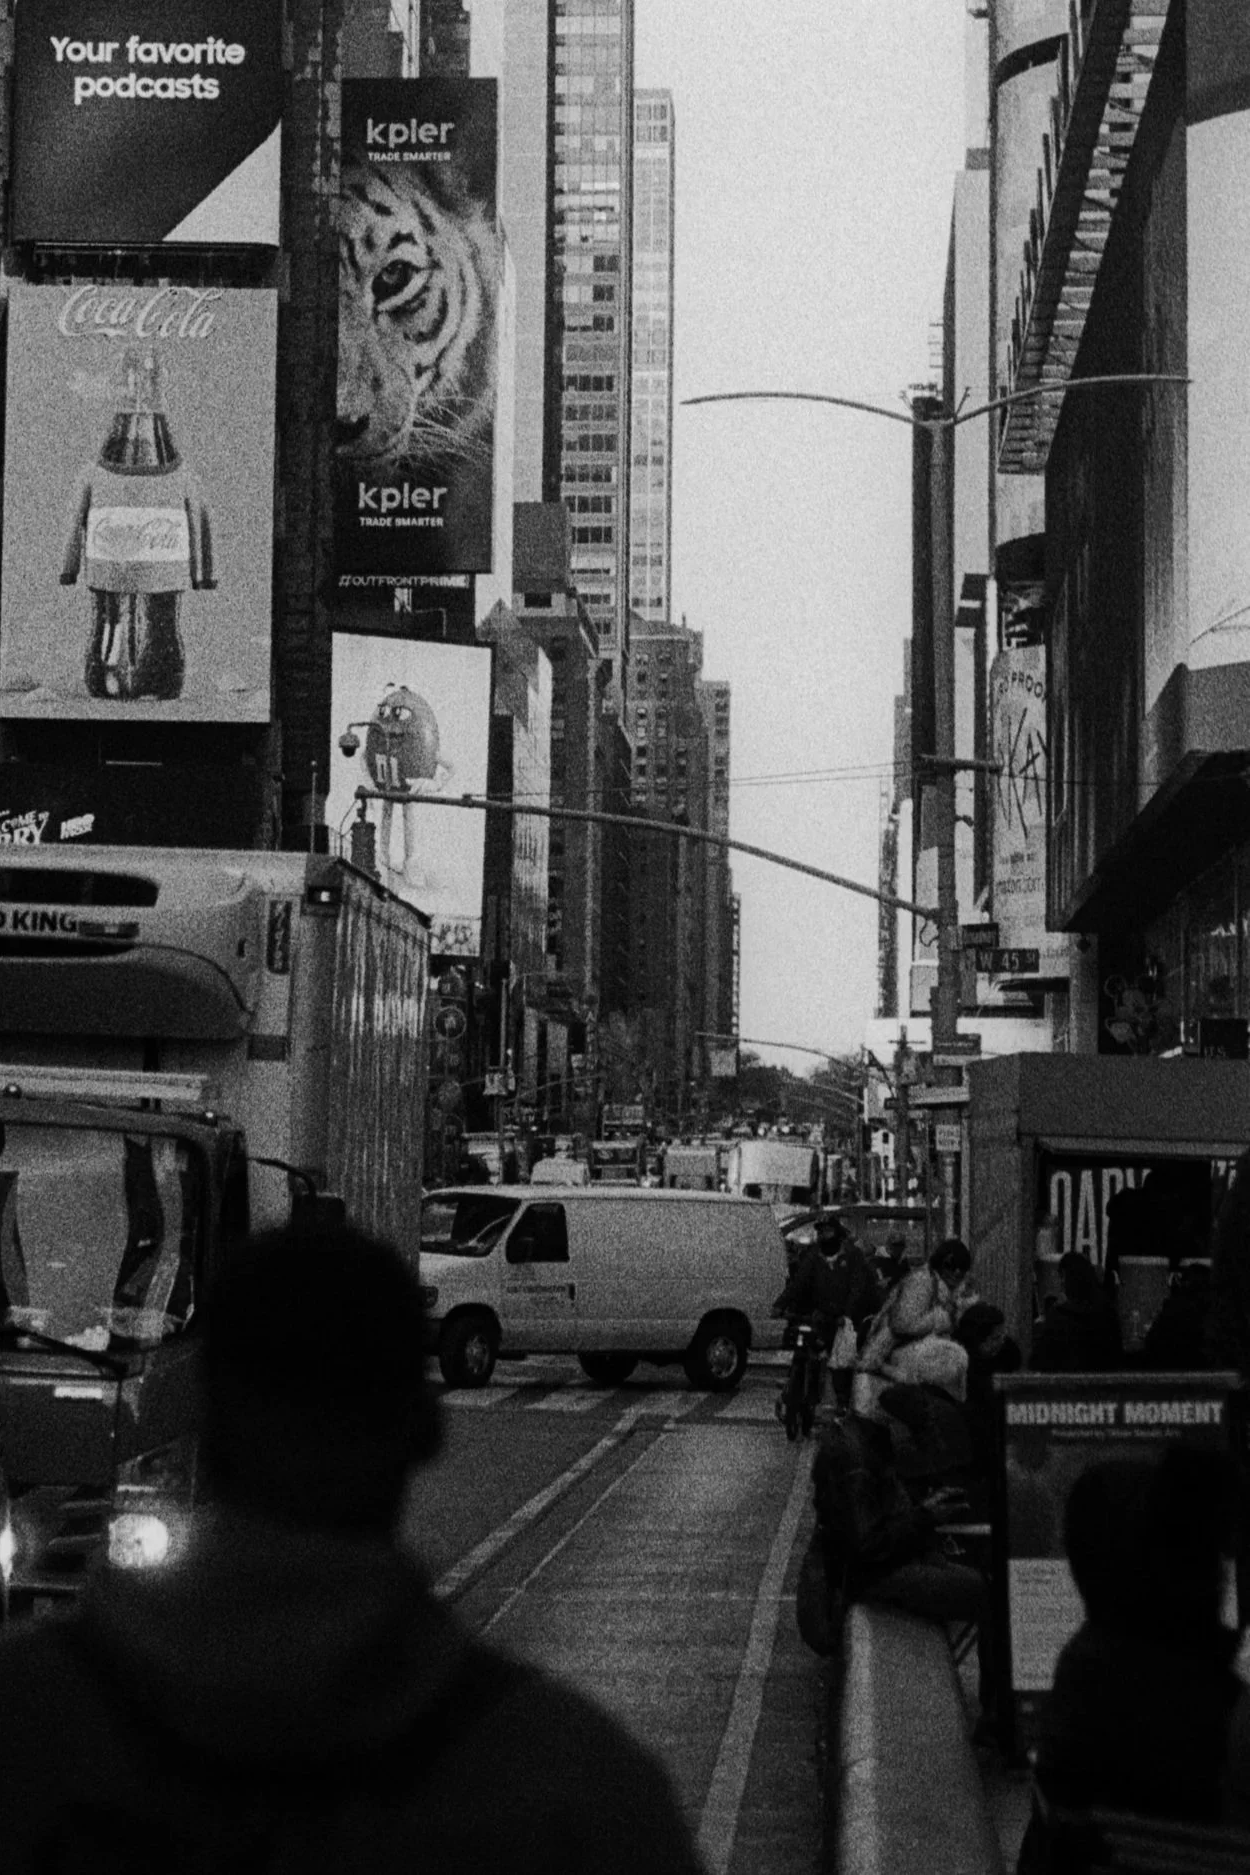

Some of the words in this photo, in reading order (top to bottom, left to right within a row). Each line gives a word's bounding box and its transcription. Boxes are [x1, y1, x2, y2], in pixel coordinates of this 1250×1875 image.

[50, 36, 120, 62] Your
[126, 35, 246, 65] favorite
[74, 72, 220, 106] podcasts
[366, 118, 455, 148] kpler
[367, 152, 399, 163] TRADE
[402, 152, 451, 163] SMARTER
[358, 482, 448, 513] kpler
[359, 516, 392, 527] TRADE
[395, 517, 444, 527] SMARTER
[1011, 671, 1046, 699] PROO
[11, 909, 79, 933] KING
[980, 951, 994, 970] W
[1001, 952, 1020, 971] 45
[1006, 1401, 1118, 1425] MIDNIGHT
[1123, 1401, 1224, 1425] MOMENT
